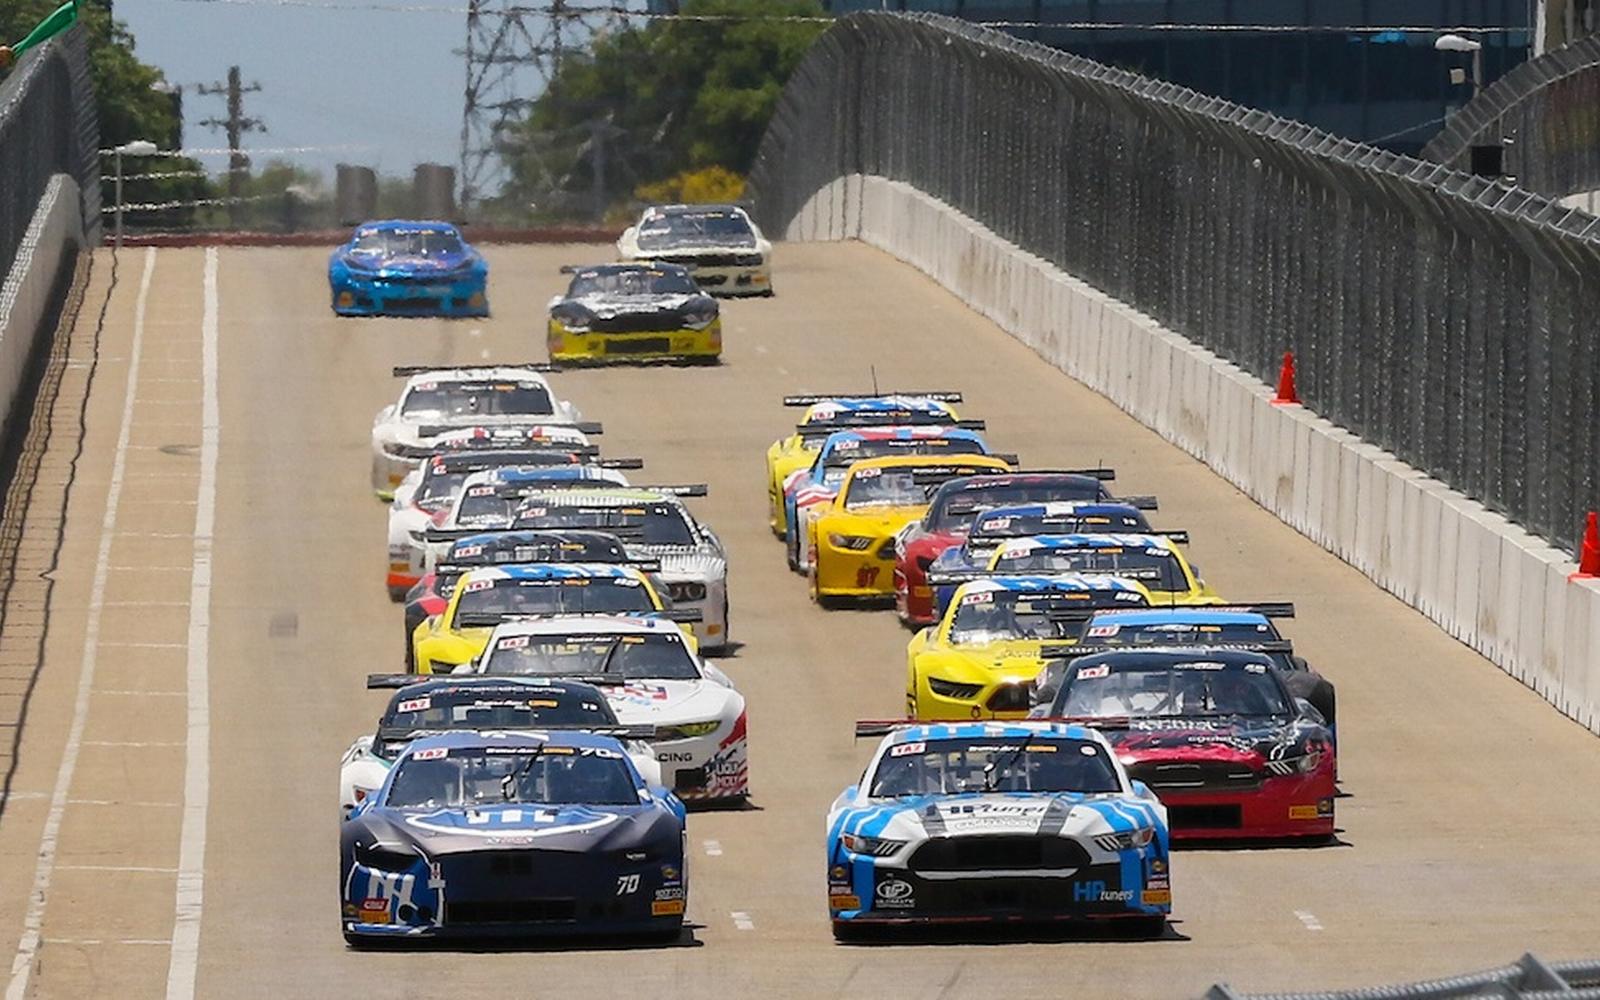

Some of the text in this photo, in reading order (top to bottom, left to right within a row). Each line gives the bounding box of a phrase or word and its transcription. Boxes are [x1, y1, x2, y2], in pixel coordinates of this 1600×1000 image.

[965, 592, 992, 604] TA2
[502, 638, 527, 648] TA2
[401, 700, 428, 710] TA2
[895, 743, 924, 754] TA2
[417, 749, 444, 760] TA2
[656, 752, 693, 762] CING
[616, 874, 641, 895] 70
